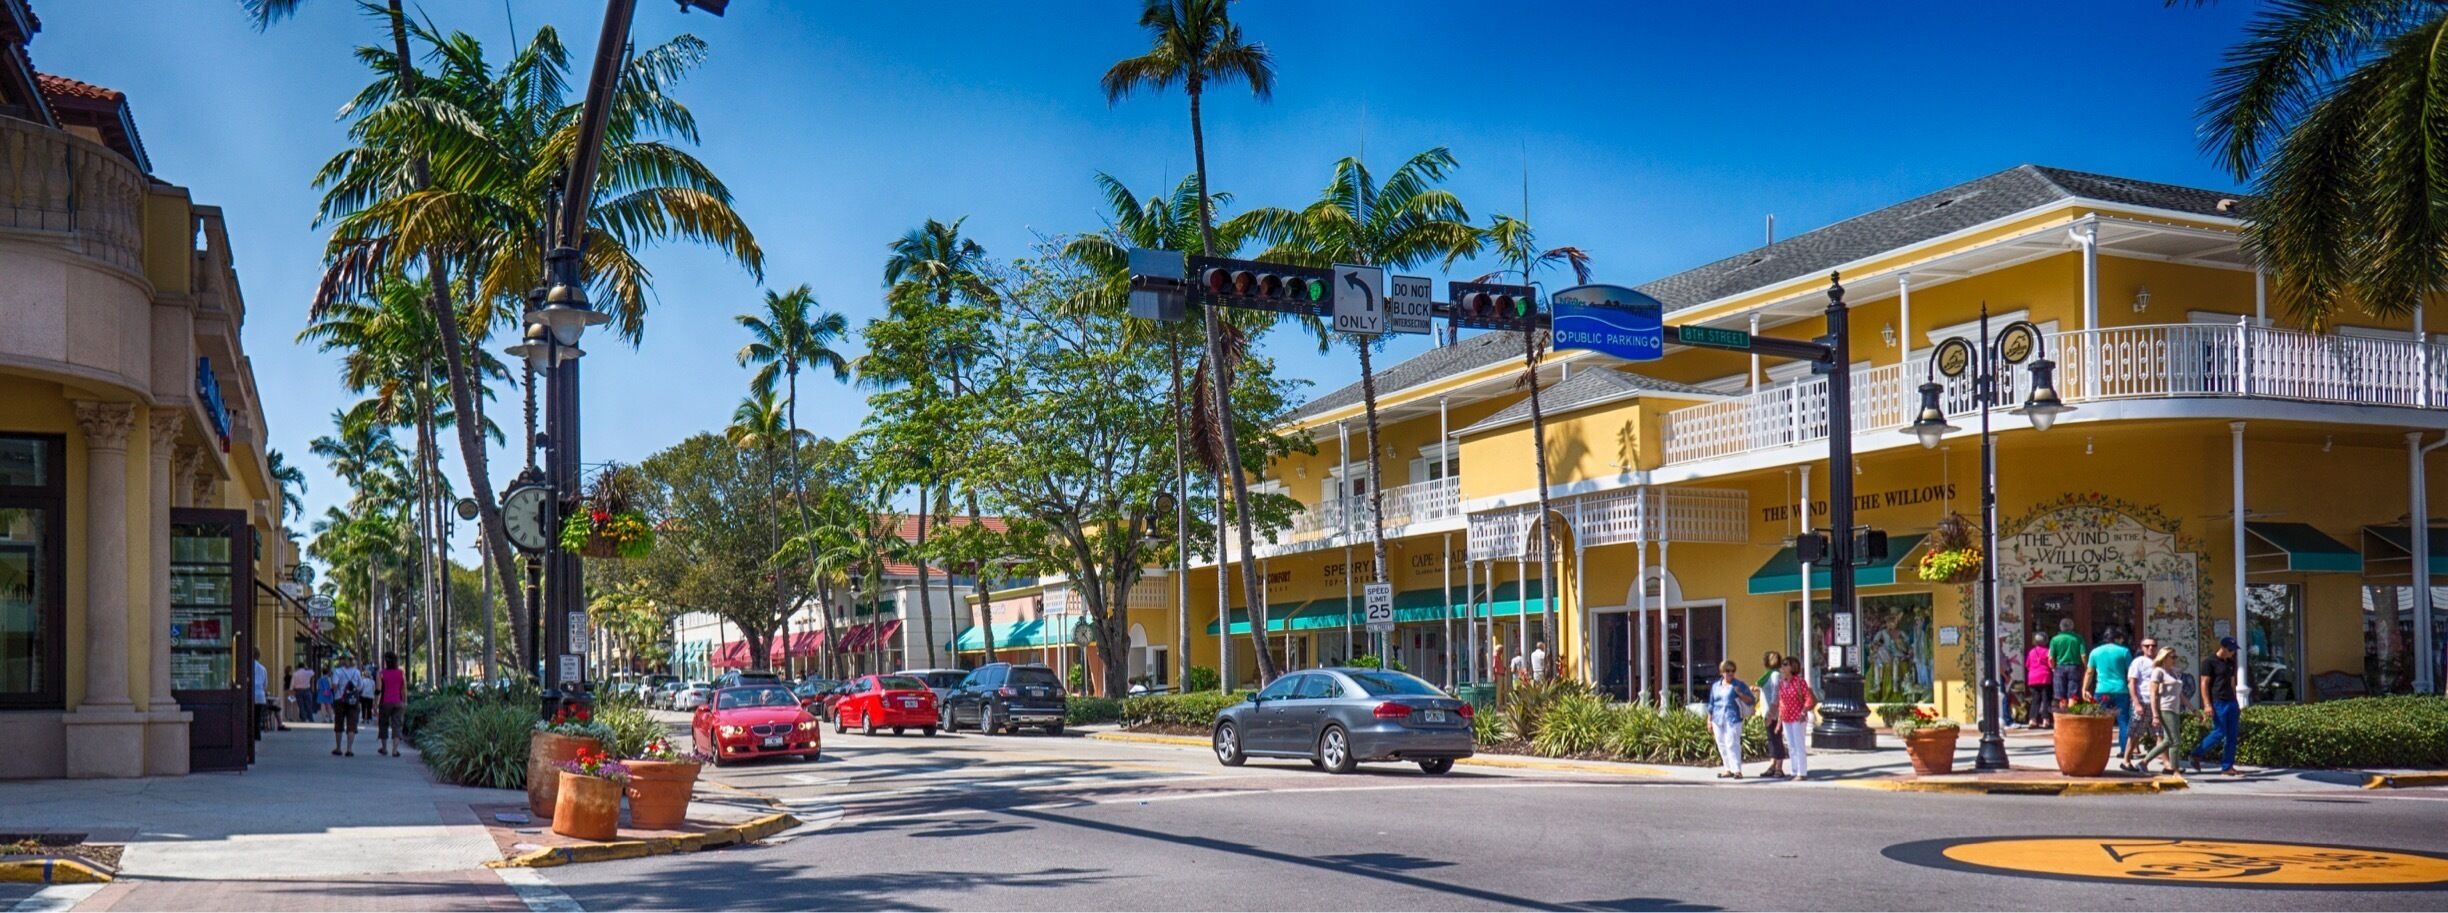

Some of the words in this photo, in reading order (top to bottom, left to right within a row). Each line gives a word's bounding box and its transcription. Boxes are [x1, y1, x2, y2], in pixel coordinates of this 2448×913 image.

[1394, 283, 1408, 297] DO
[1411, 285, 1430, 298] NOT
[1393, 301, 1429, 316] BLOCK
[1339, 314, 1377, 330] ONLY
[1392, 318, 1430, 329] INTERSECTION
[1567, 332, 1602, 344] PUBLIC
[1606, 334, 1648, 348] PARKING
[1709, 332, 1744, 345] STREET
[1762, 505, 1788, 522] THE
[1792, 500, 1827, 518] WND
[1885, 483, 1956, 507] WILLOWS
[2022, 532, 2053, 547] THE
[2056, 531, 2110, 549] WIND
[2124, 533, 2140, 541] THE
[2037, 546, 2119, 564] WILLOWS
[2063, 565, 2100, 583] 793
[1367, 587, 1389, 595] SPEED
[1369, 603, 1390, 619] 25
